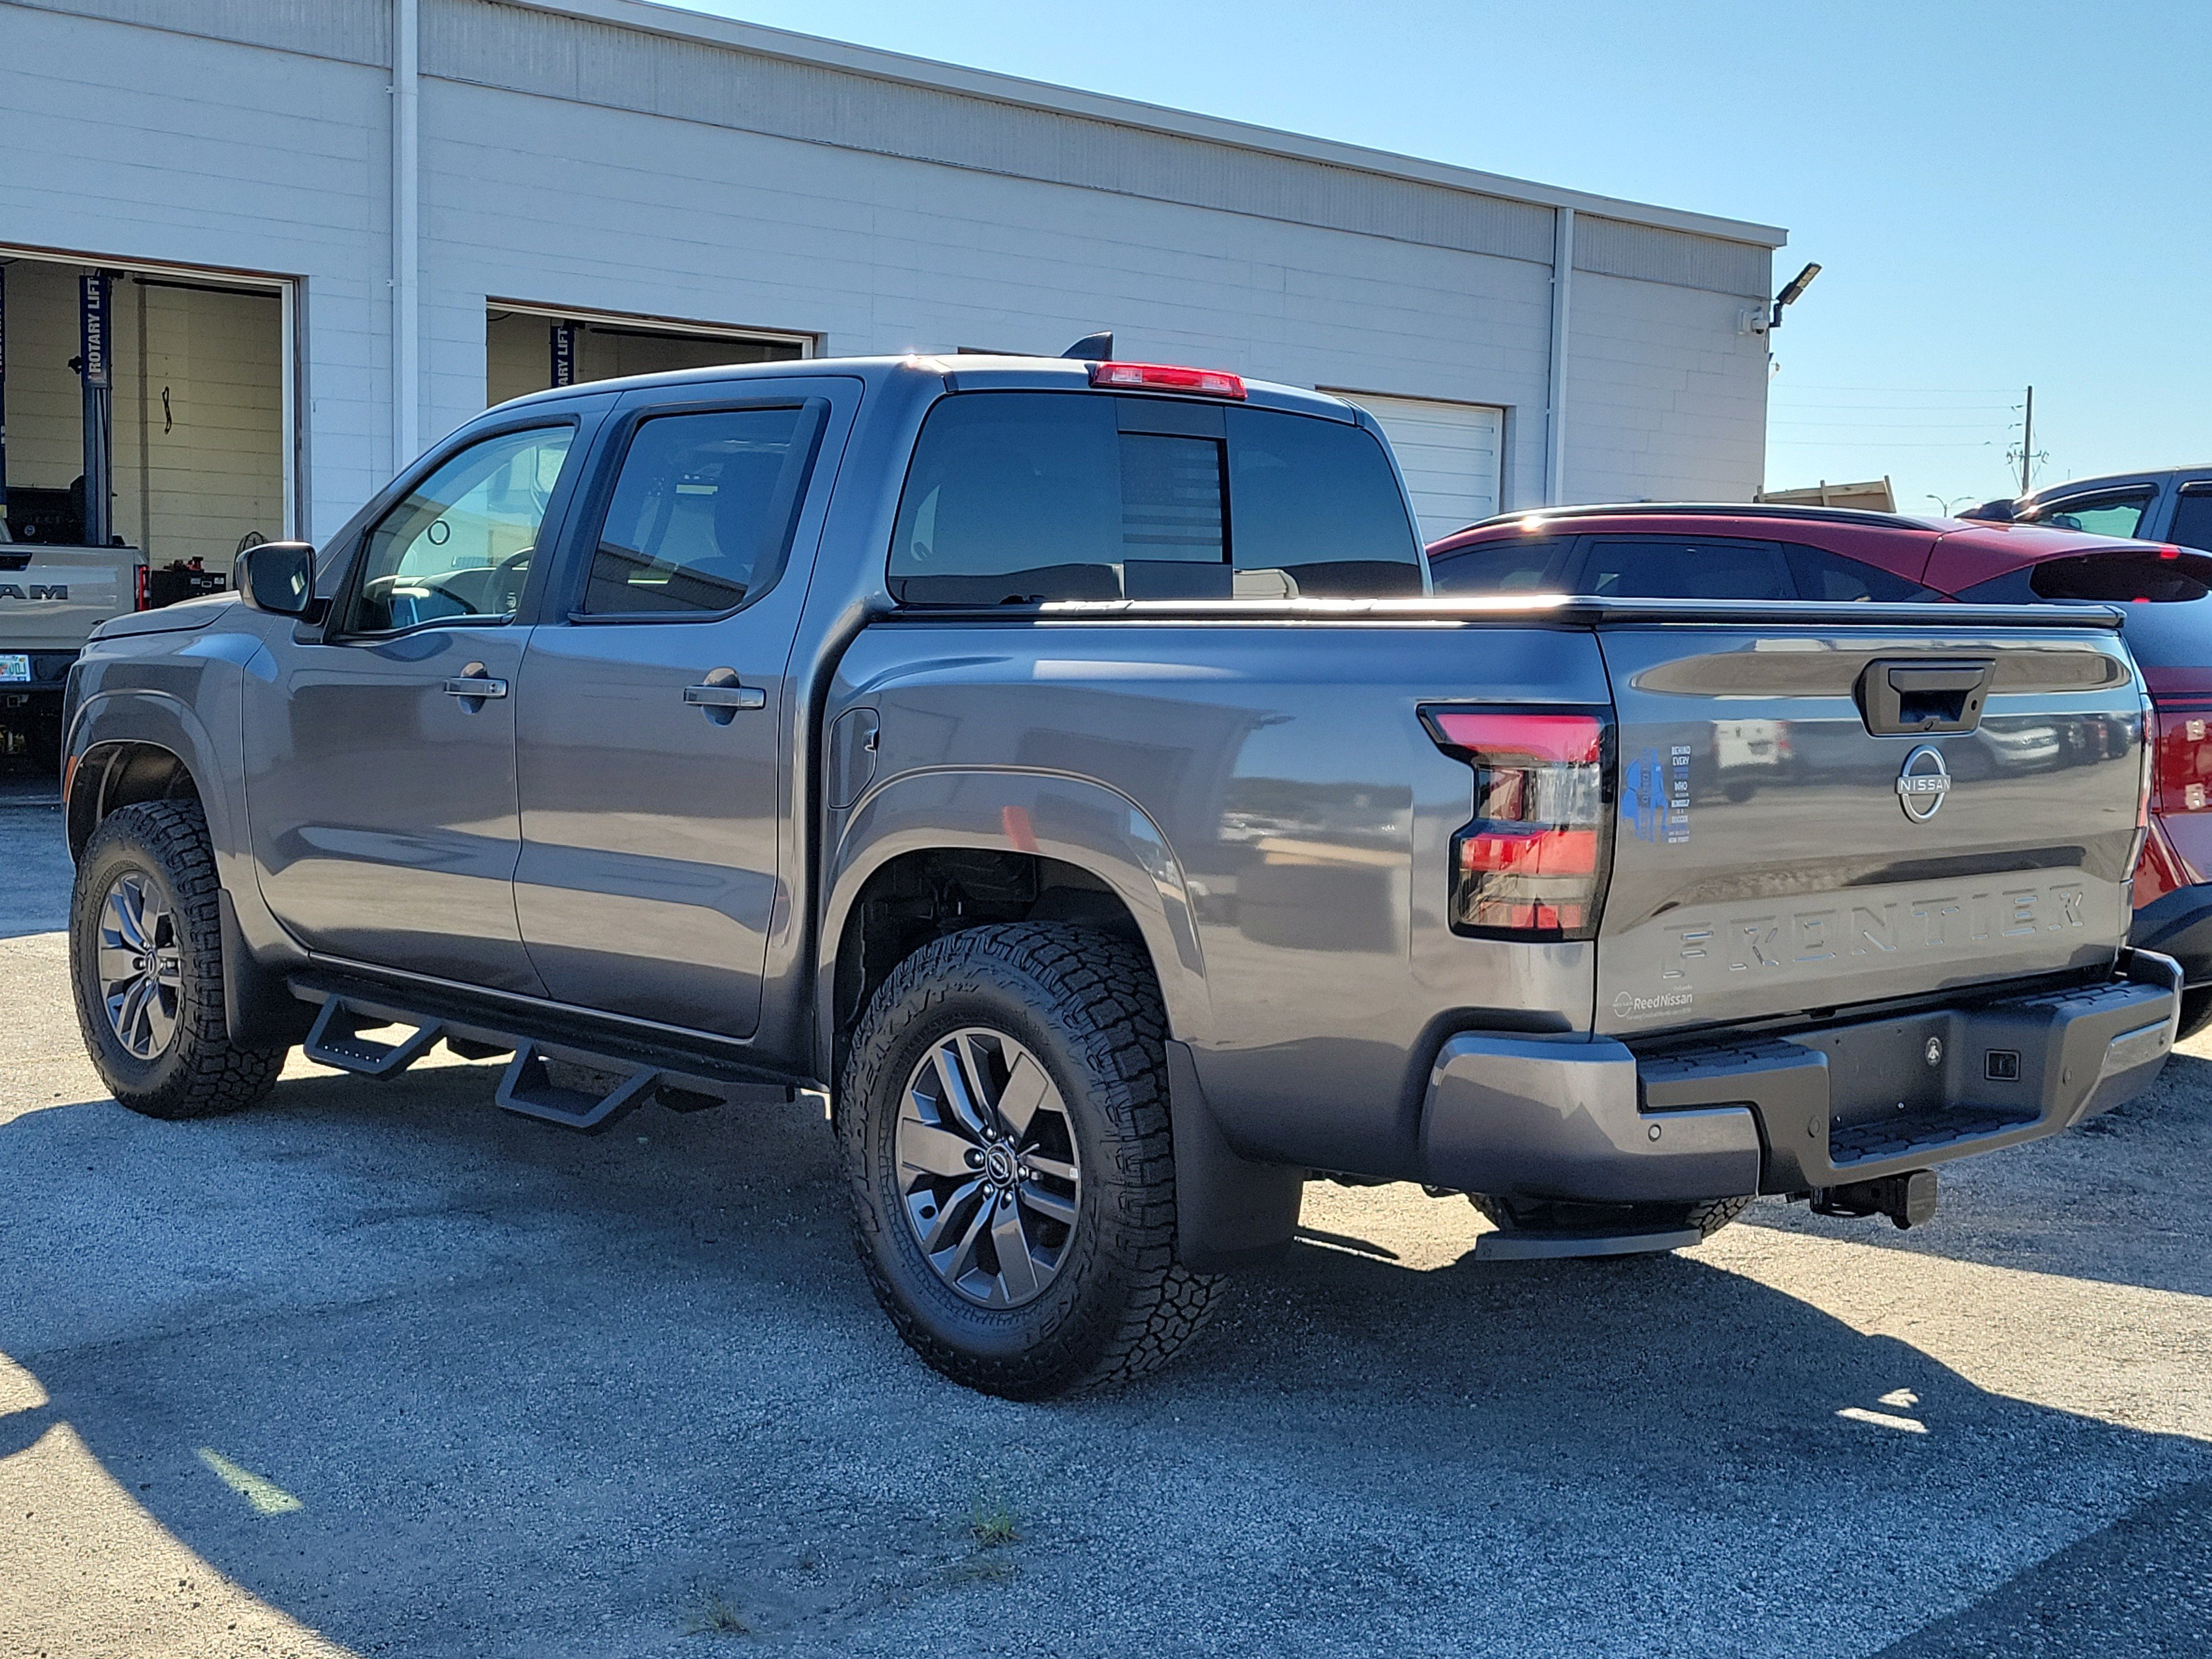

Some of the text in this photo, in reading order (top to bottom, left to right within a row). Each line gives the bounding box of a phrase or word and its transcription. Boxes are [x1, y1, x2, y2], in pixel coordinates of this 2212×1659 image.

[87, 277, 101, 373] ROTARY LIFT
[557, 328, 568, 386] ARY LIFT
[1673, 756, 1690, 765] EVERY
[1674, 781, 1688, 791] WHO
[1900, 778, 1950, 791] NISSAN
[1662, 883, 2084, 979] FRONTIER
